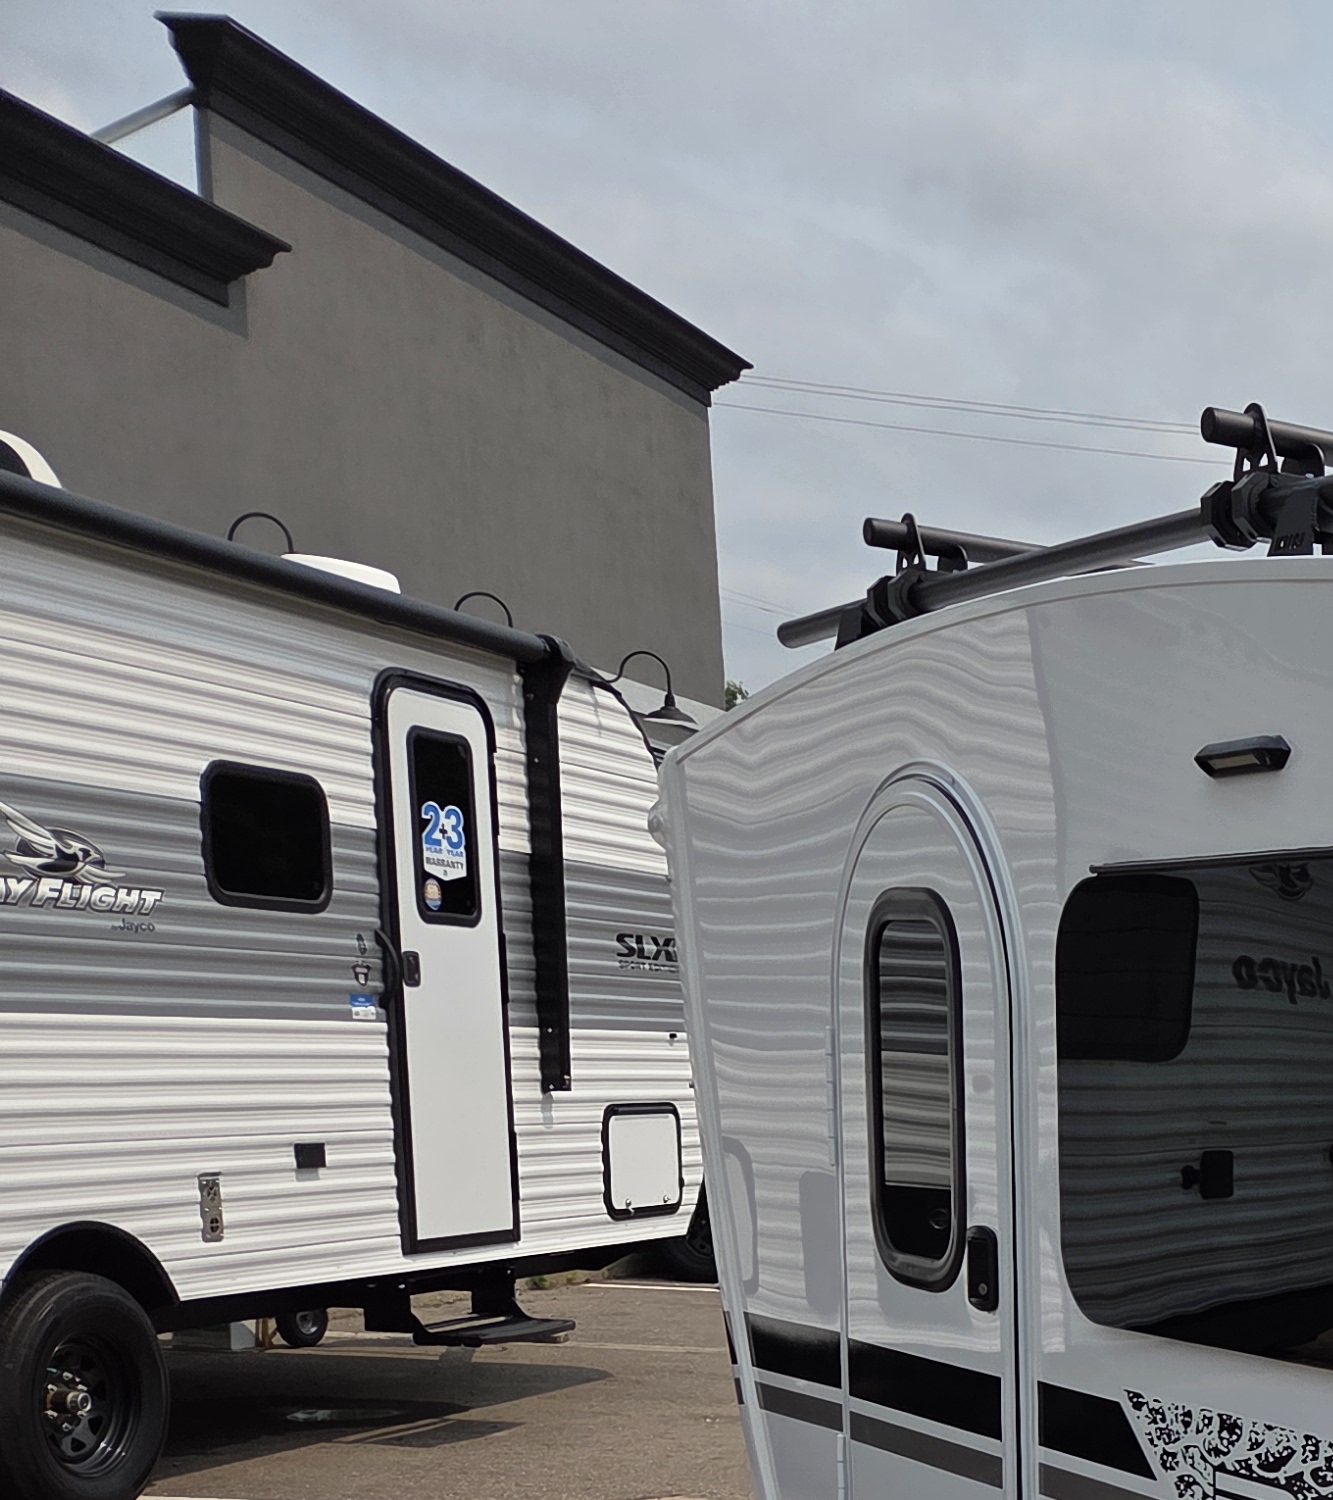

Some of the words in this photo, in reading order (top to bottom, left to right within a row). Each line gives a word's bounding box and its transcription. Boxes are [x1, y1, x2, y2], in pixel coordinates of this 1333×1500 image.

[425, 857, 464, 870] WARRANTY
[30, 876, 165, 916] FLIGHT
[119, 917, 155, 934] Jayco
